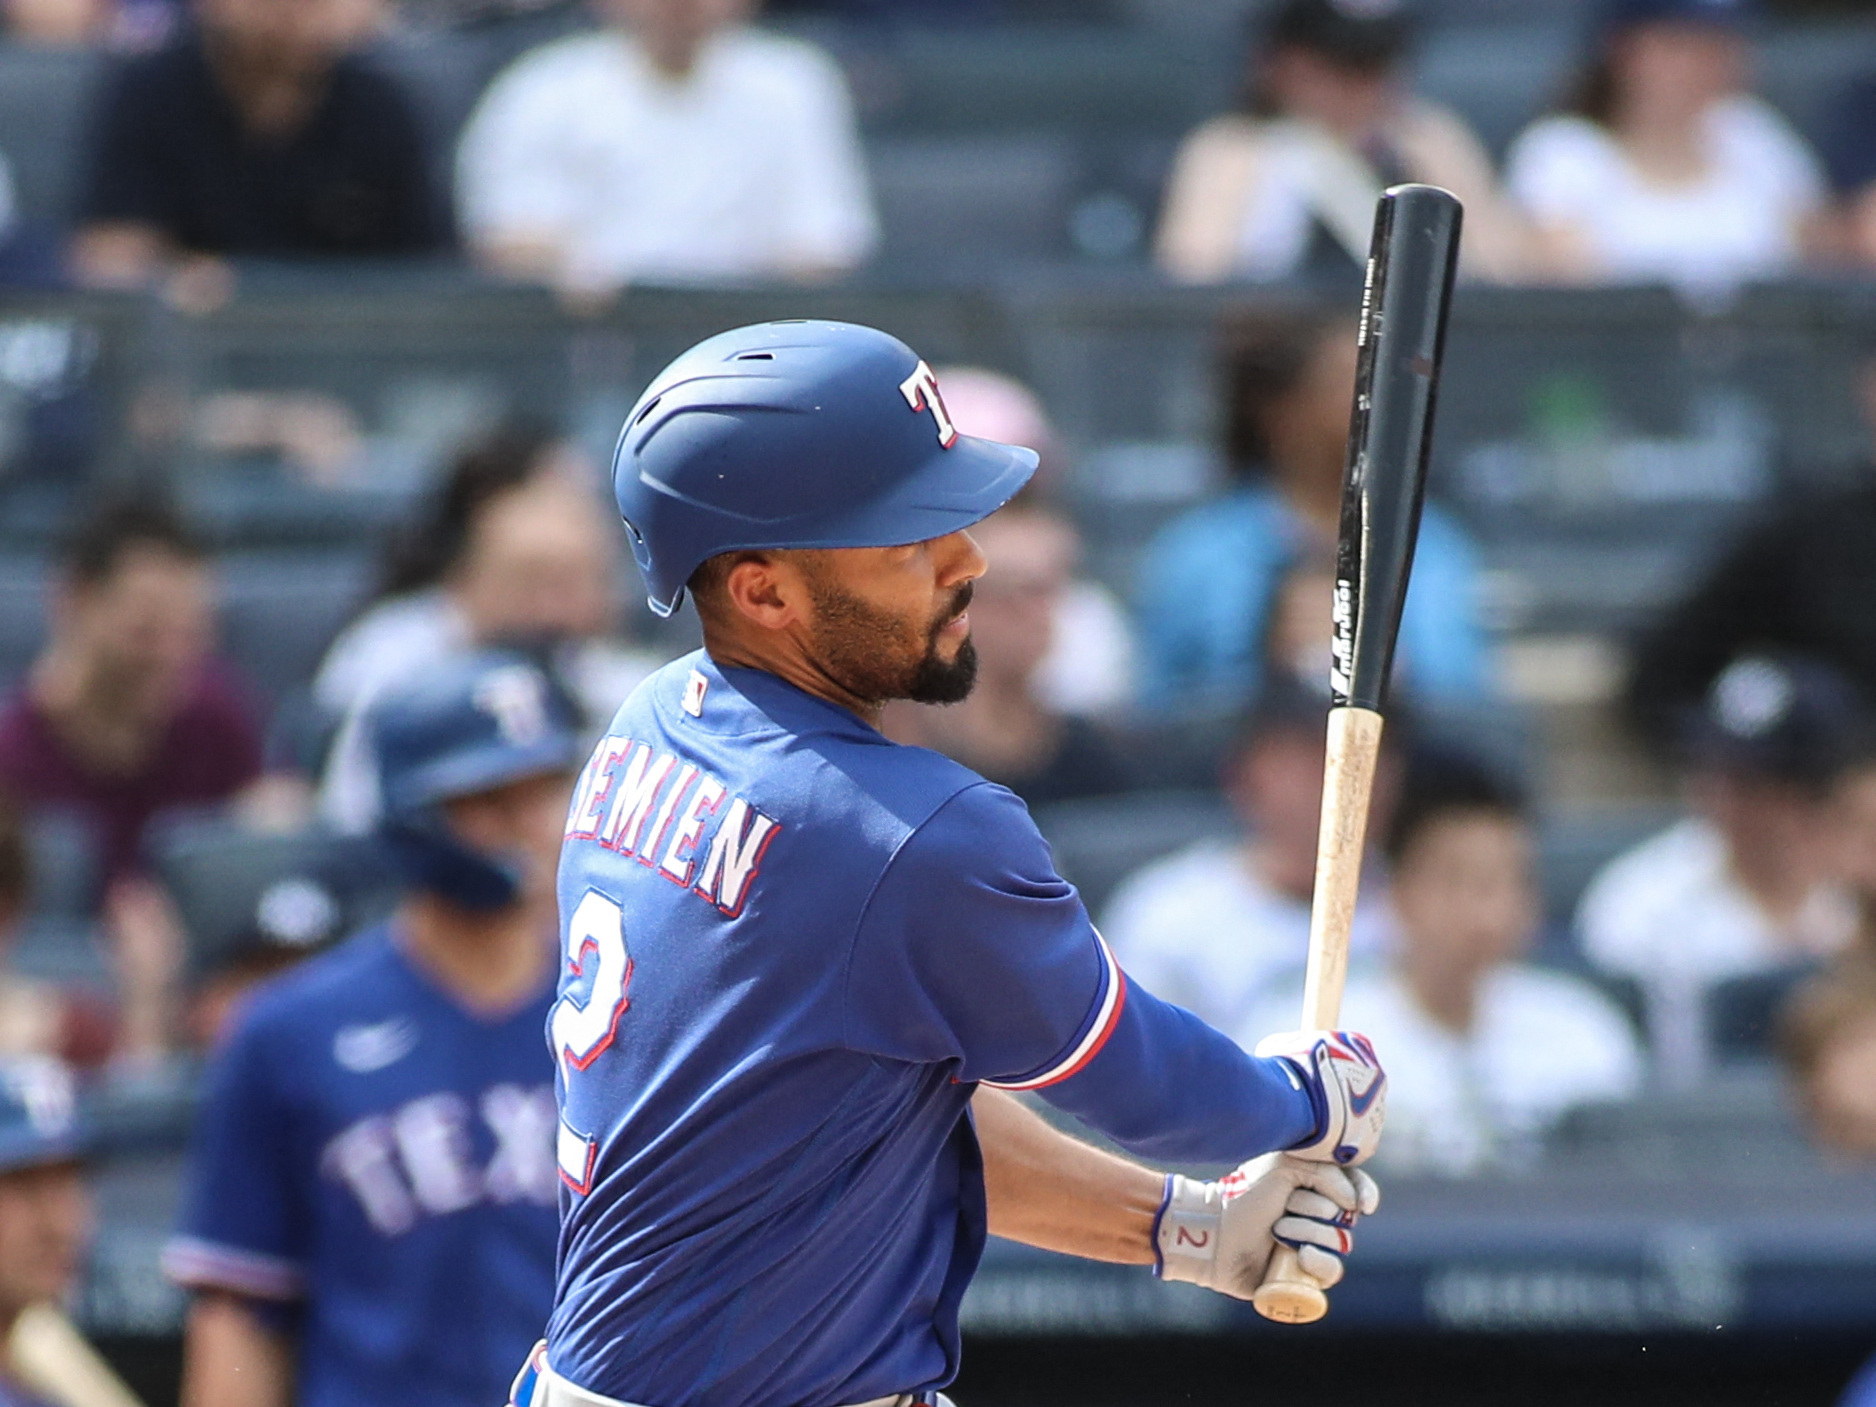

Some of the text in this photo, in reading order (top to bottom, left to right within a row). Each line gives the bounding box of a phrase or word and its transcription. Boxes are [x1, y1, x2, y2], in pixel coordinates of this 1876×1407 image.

[898, 359, 959, 450] T
[551, 886, 633, 1197] 2
[319, 1083, 559, 1235] TEX
[1177, 1226, 1208, 1248] 2
